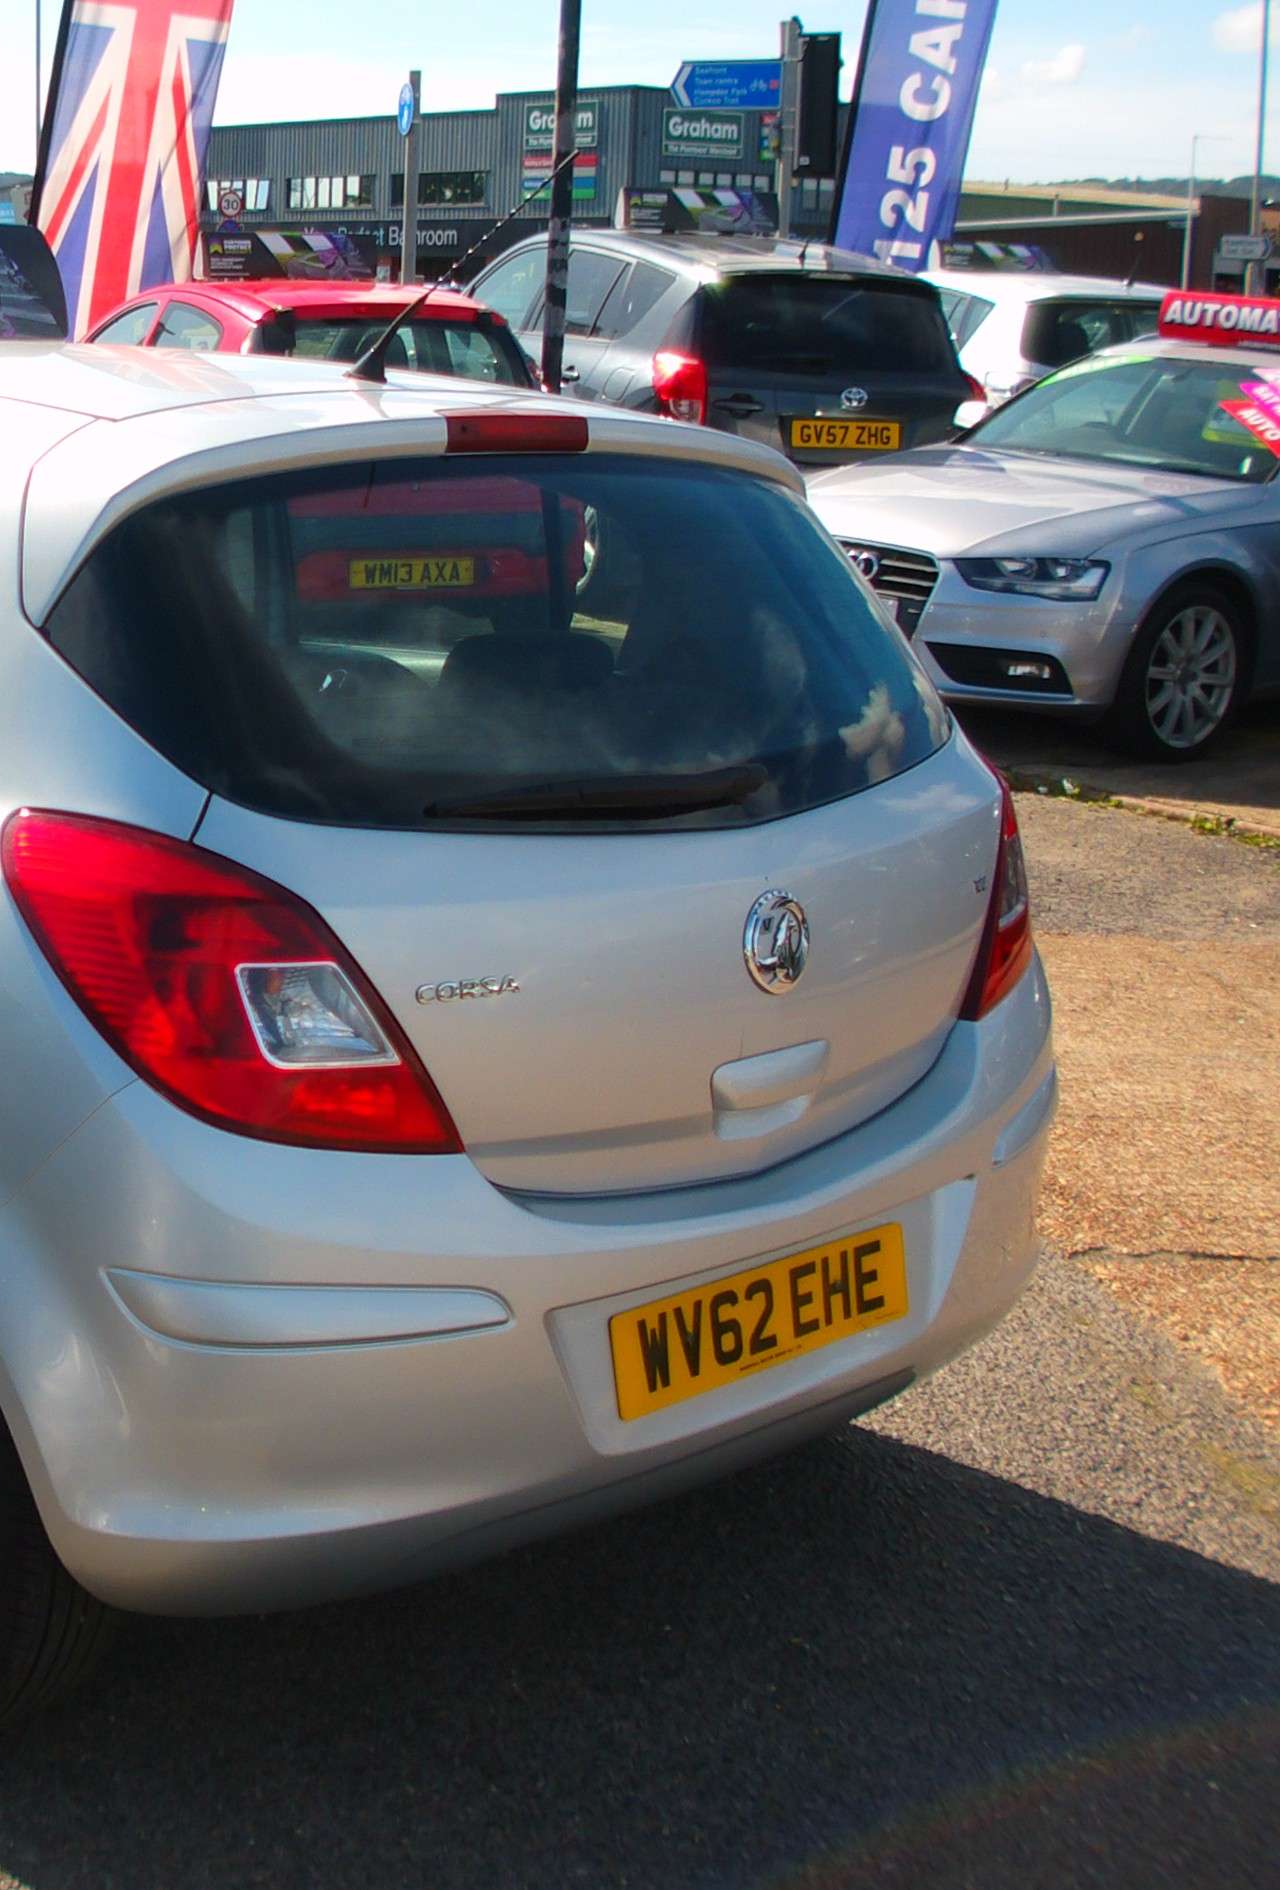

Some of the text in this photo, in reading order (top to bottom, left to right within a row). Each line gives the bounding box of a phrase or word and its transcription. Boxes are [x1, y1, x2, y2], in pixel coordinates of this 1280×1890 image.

[528, 110, 593, 131] Gram
[668, 115, 739, 140] Graham
[224, 198, 239, 210] 30
[873, 146, 937, 265] 125
[388, 225, 458, 246] Baroom
[1163, 299, 1280, 334] AUTOMA
[800, 423, 891, 446] GV57 ZHG
[364, 560, 461, 585] WM13 AXA
[415, 973, 521, 1006] CORSA
[636, 1239, 886, 1394] WV62 EHE
